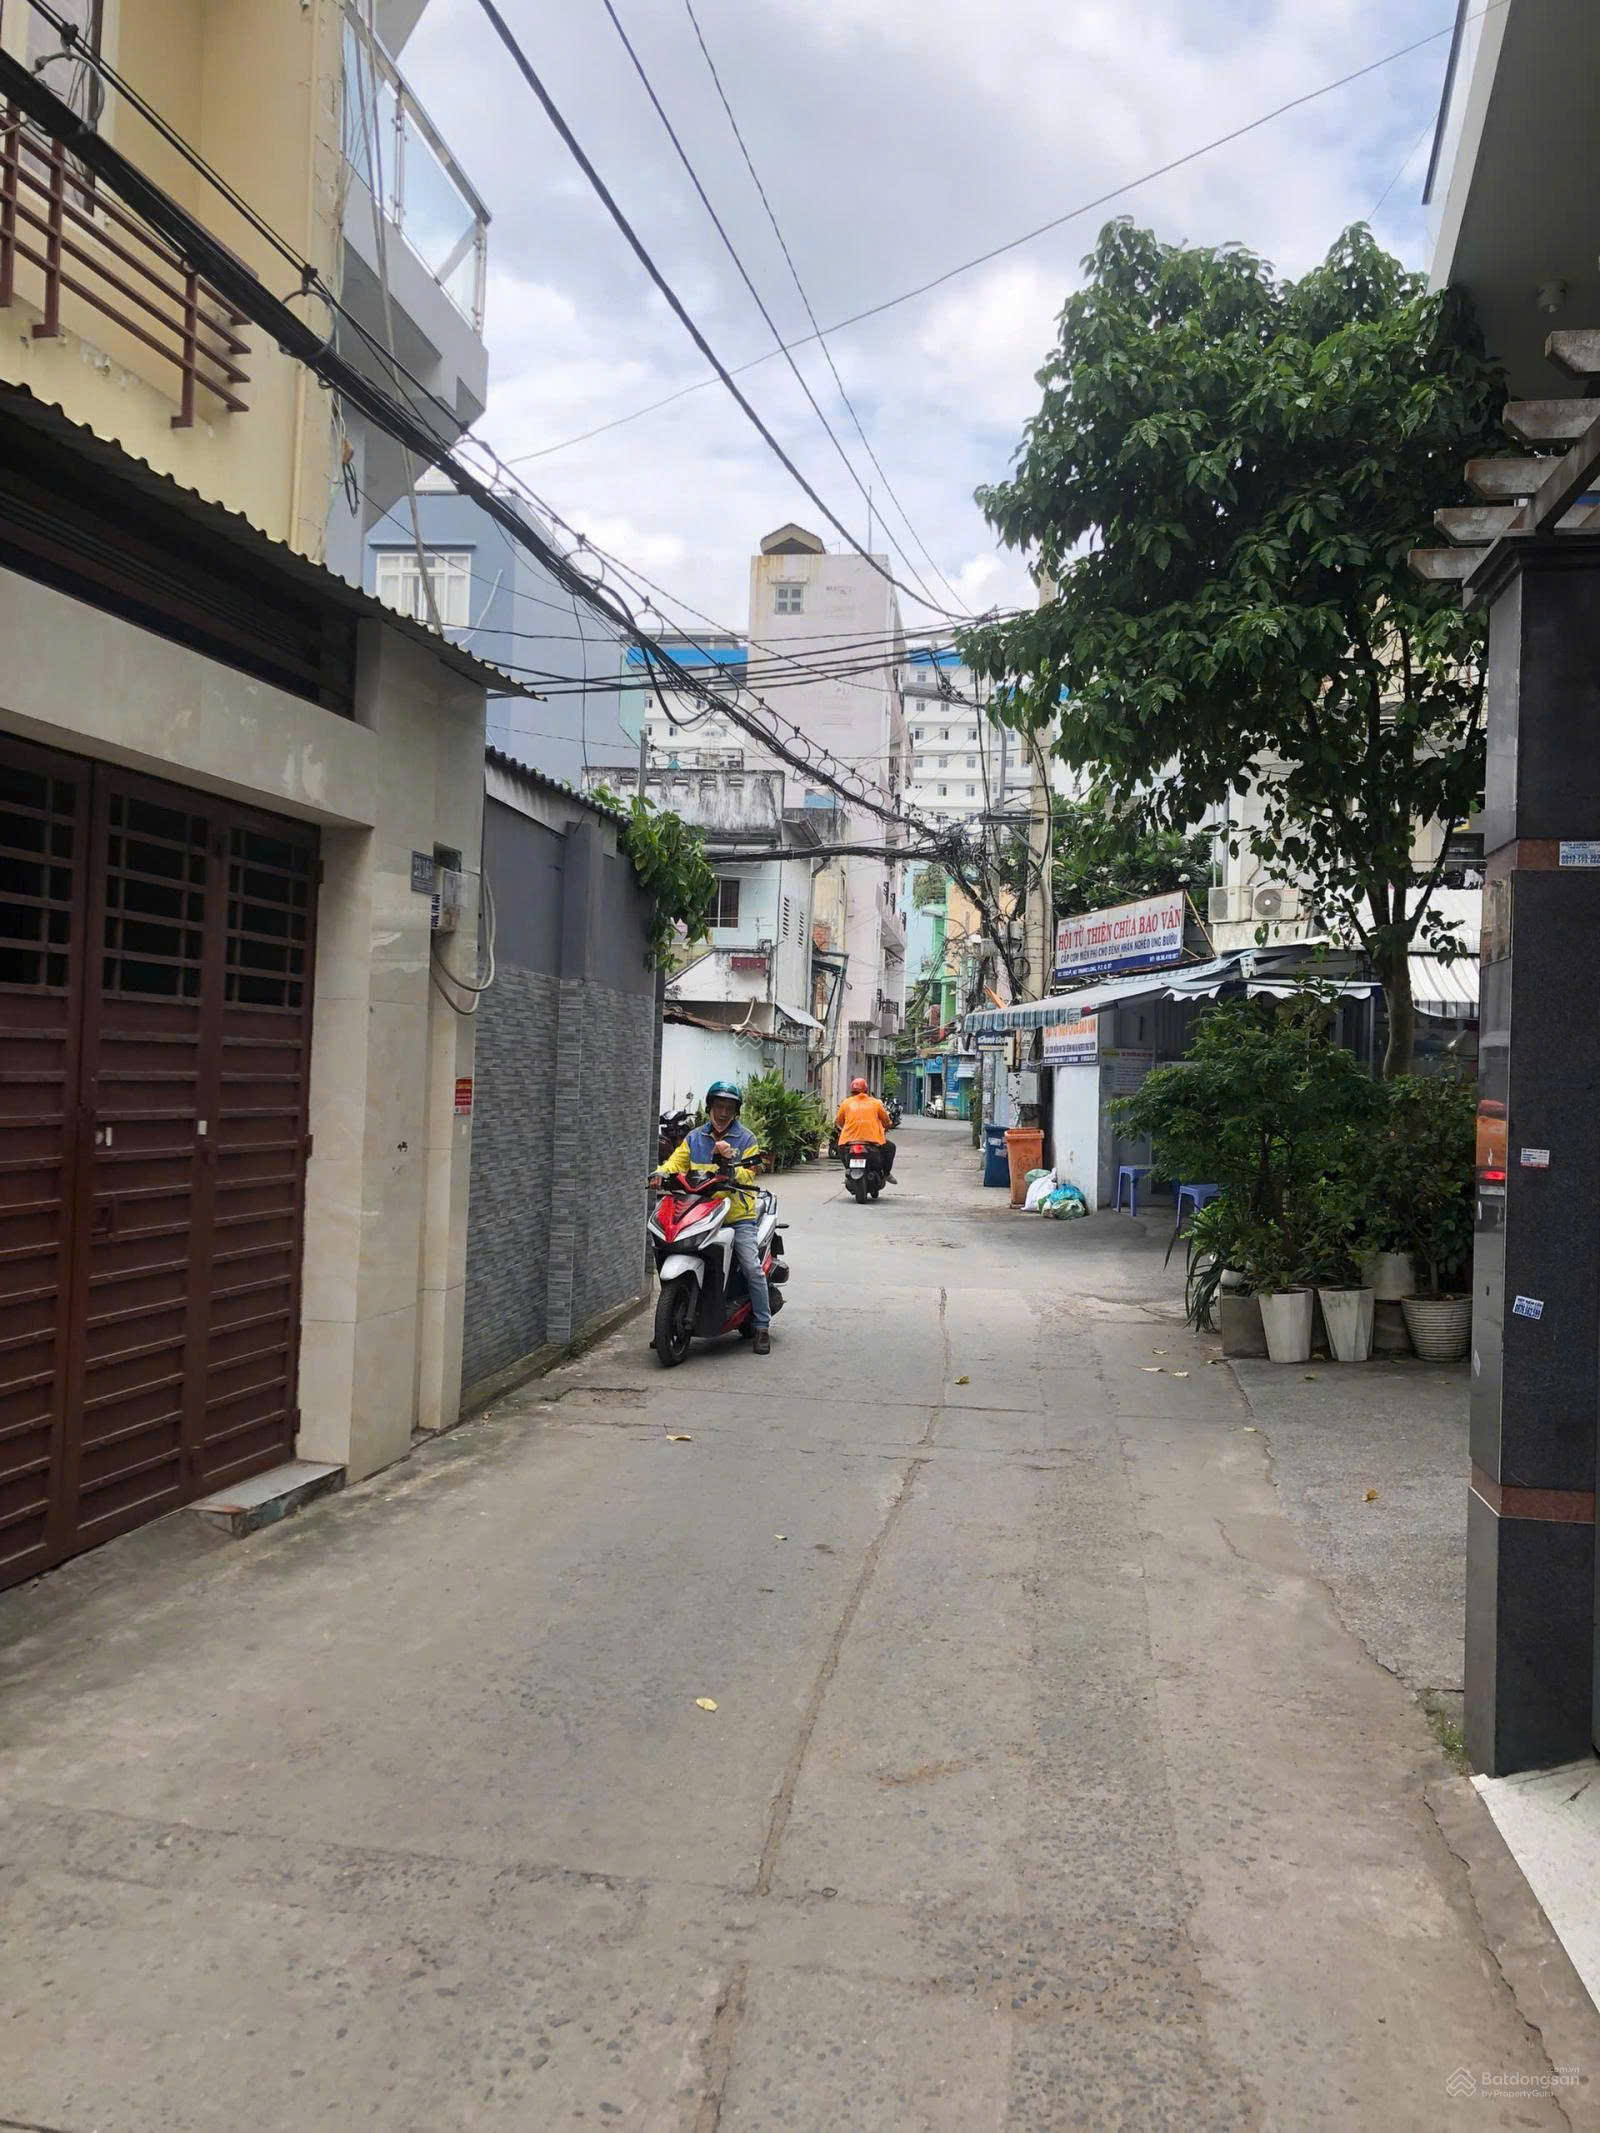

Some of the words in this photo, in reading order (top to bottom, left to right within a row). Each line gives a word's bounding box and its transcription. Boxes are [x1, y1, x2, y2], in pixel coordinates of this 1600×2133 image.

[1058, 930, 1072, 951] HỘI
[1074, 925, 1085, 948] TỪ
[1087, 922, 1112, 946] THIỆN
[1113, 914, 1136, 940] CHÙA
[1138, 907, 1159, 934] BẢO
[1161, 905, 1182, 929] VÂN
